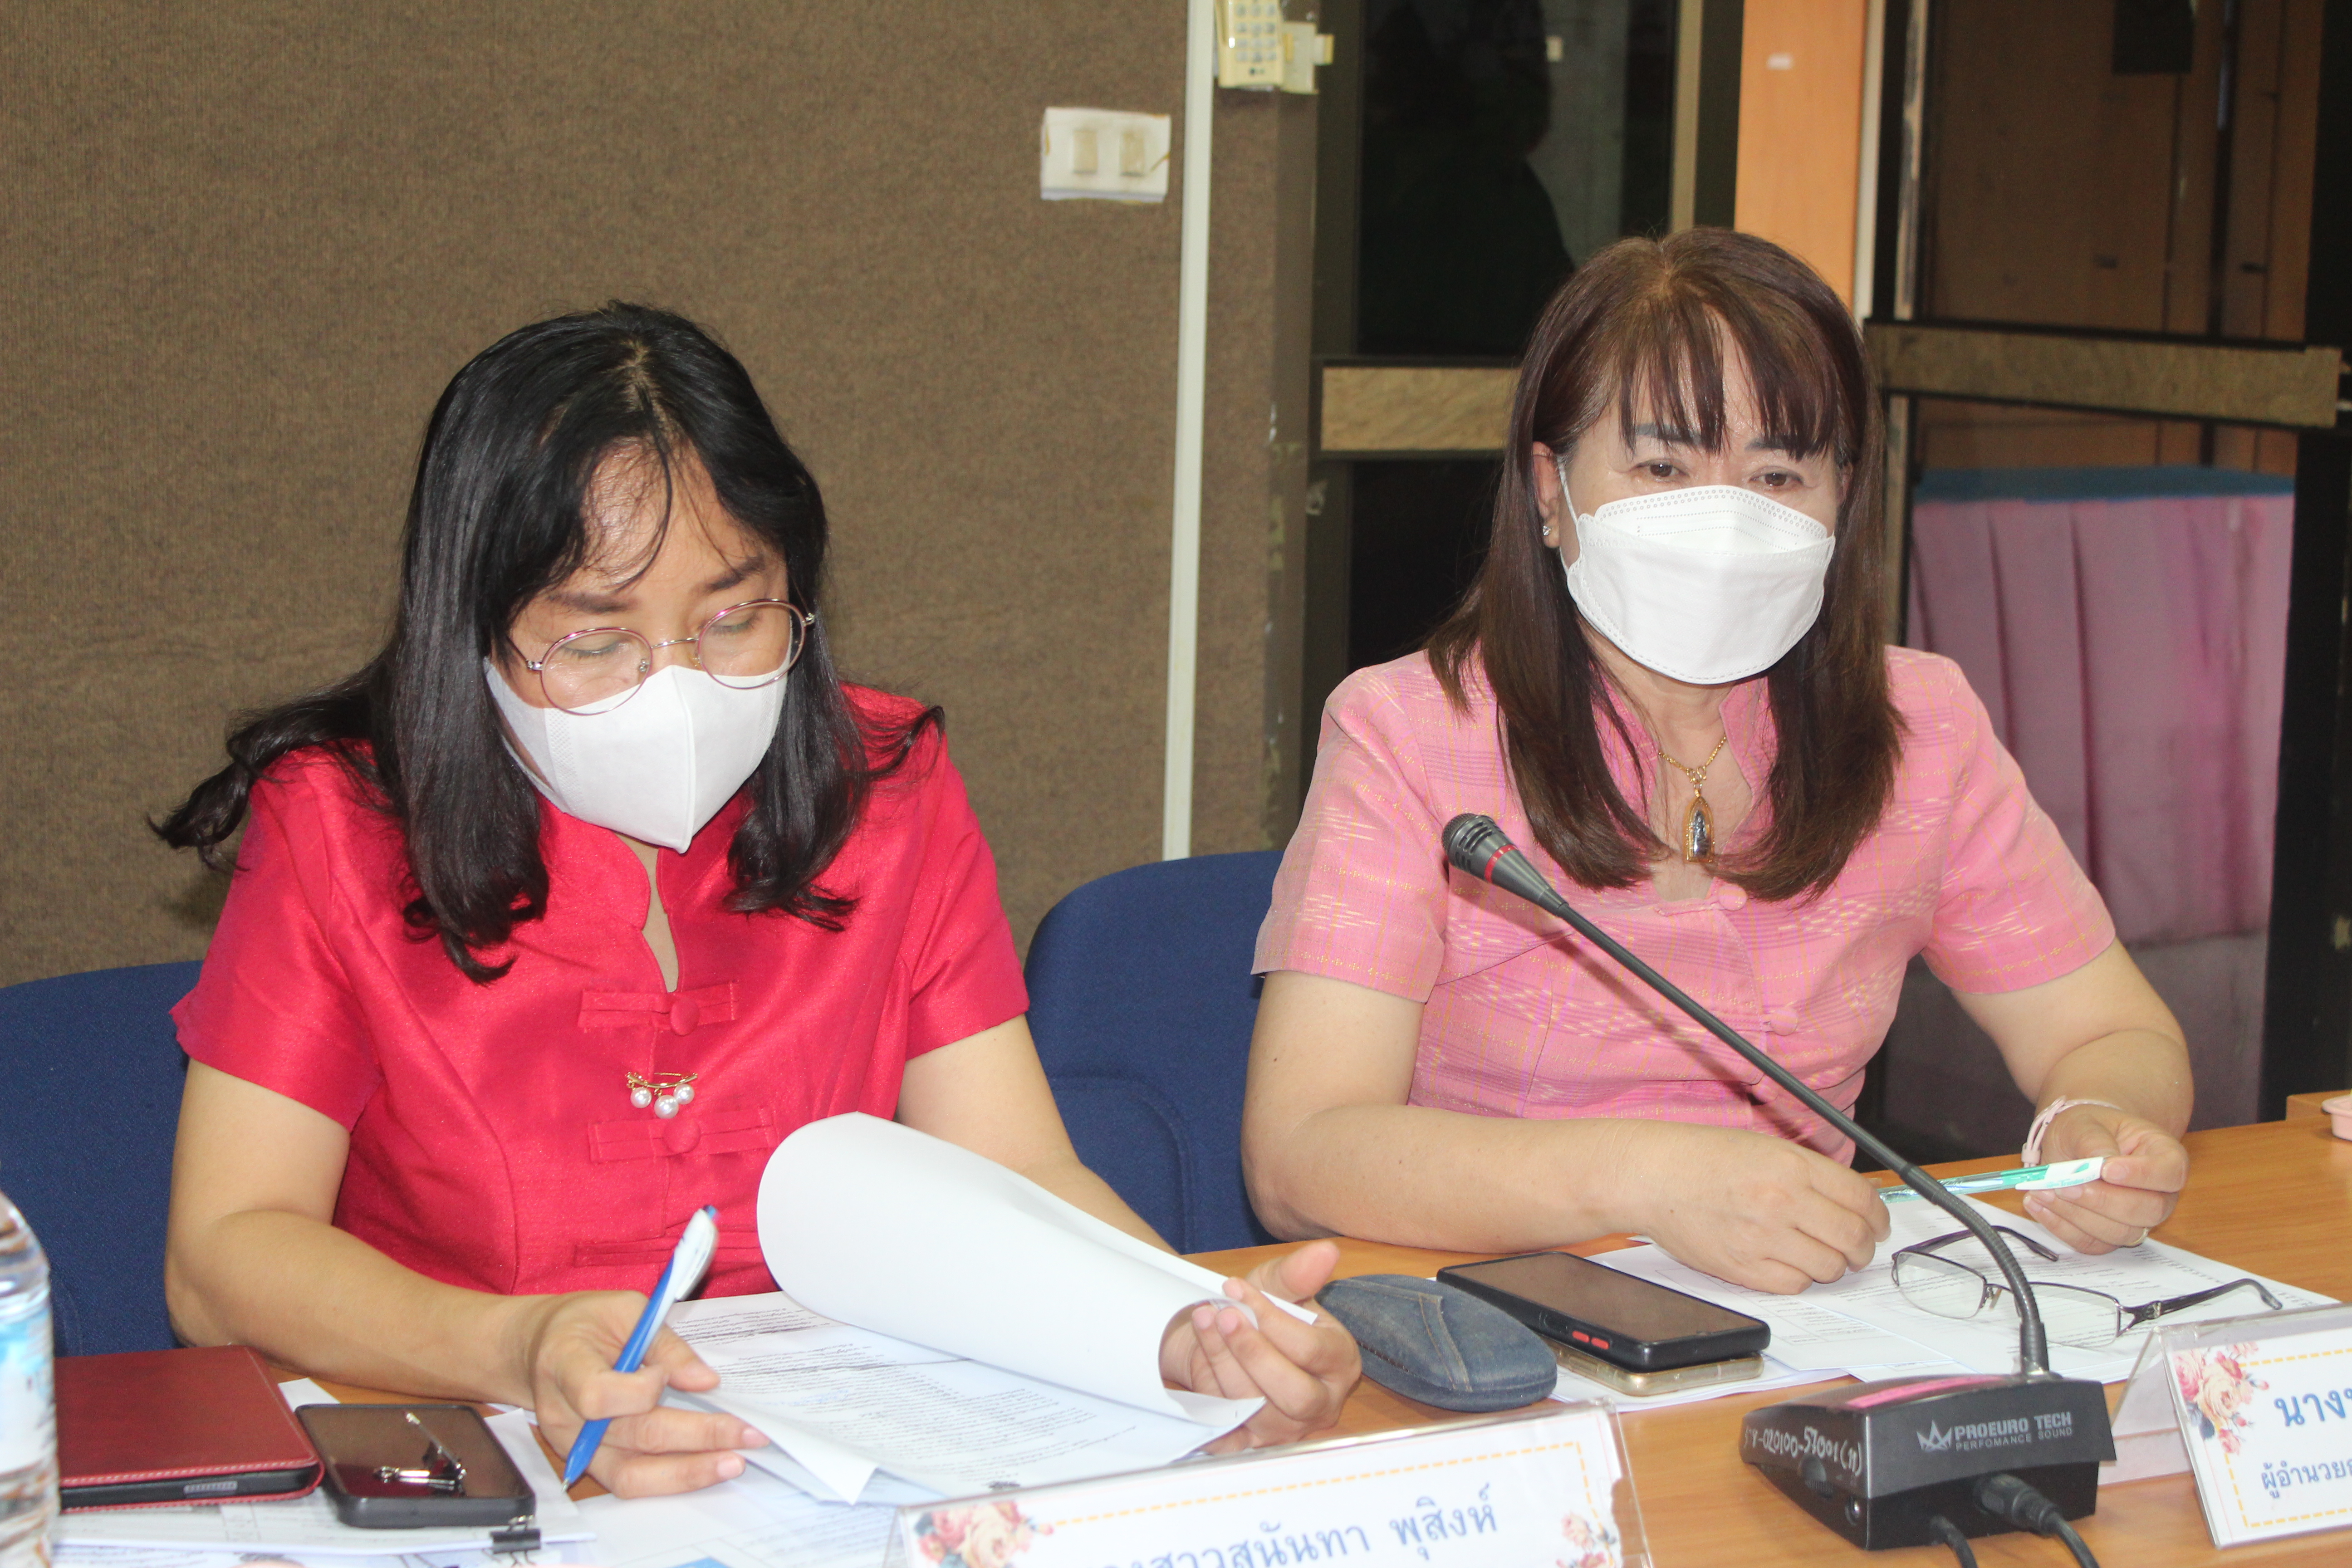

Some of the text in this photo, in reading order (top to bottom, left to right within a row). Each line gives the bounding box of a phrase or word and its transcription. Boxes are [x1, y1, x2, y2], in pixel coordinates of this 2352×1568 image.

[1954, 1411, 2073, 1441] PROEURO TECH
[1955, 1426, 2073, 1451] PERFOMANCE SOUND
[1389, 1482, 1497, 1560] พุสิงห์
